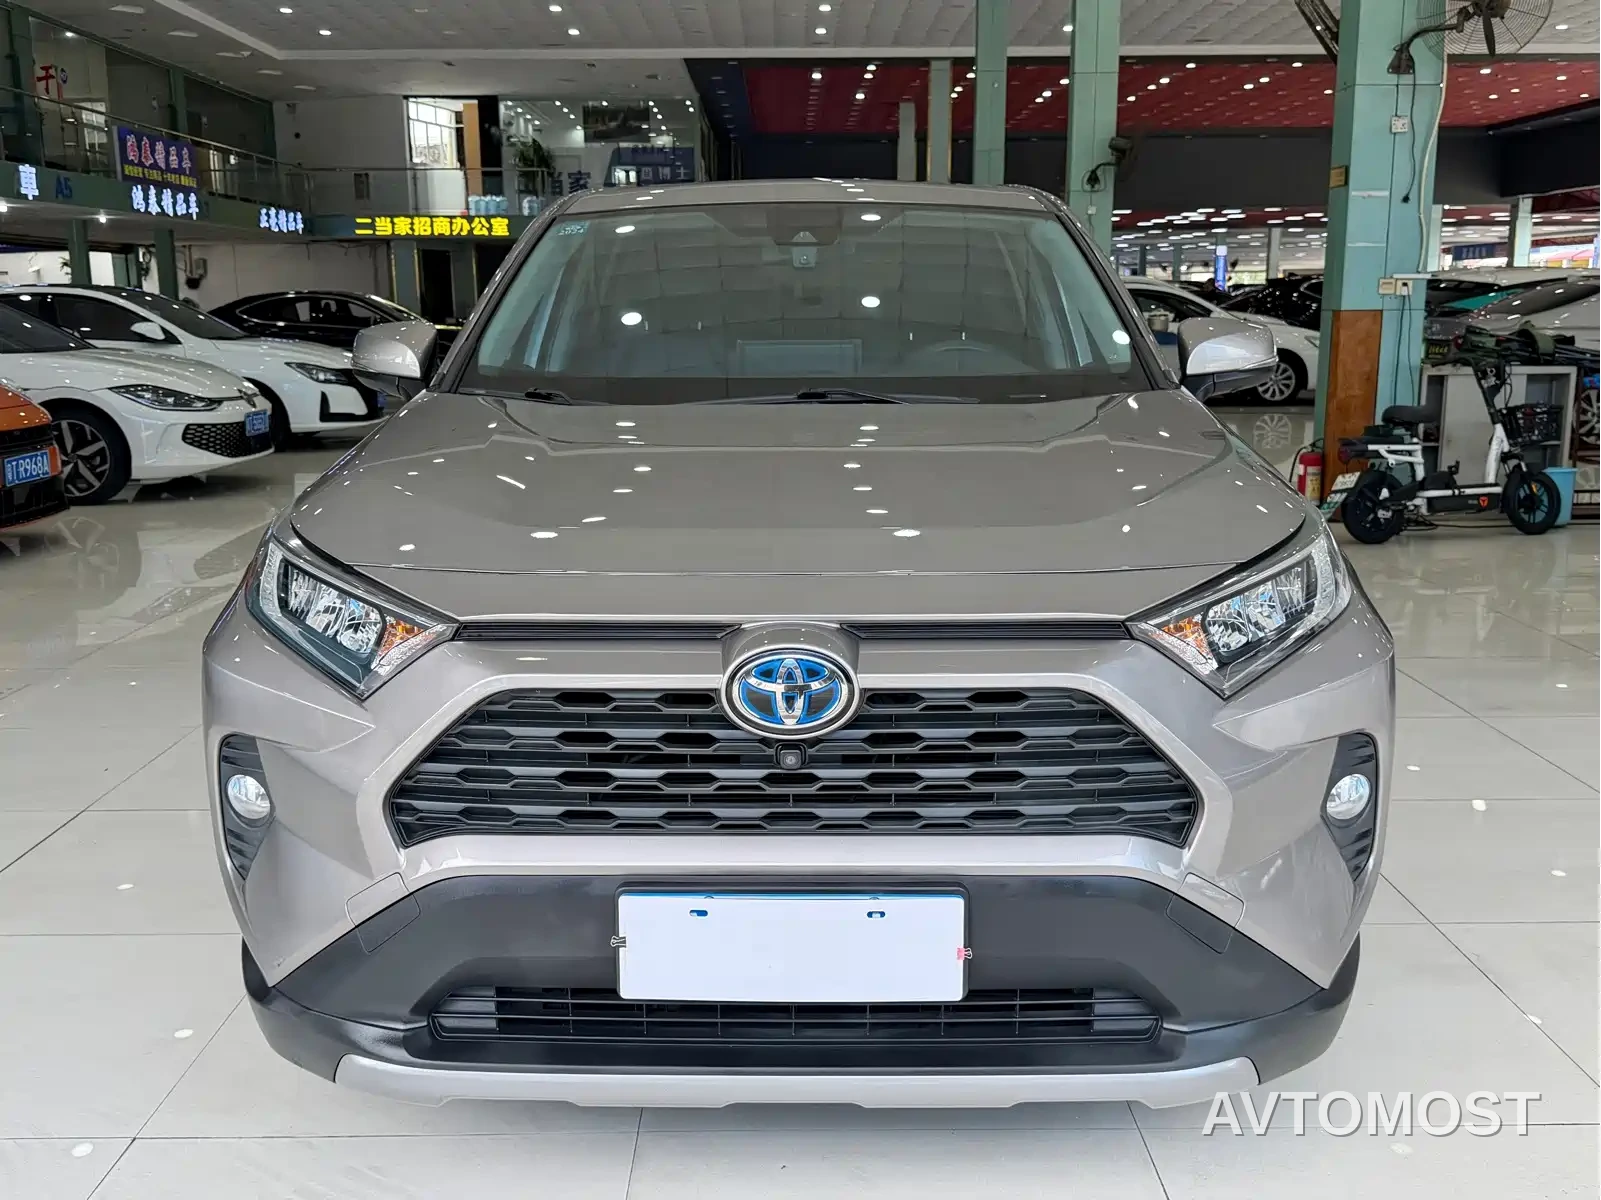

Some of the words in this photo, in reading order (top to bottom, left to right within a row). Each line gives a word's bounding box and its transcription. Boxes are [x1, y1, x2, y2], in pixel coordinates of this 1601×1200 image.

[17, 163, 40, 201] 車
[354, 216, 510, 237] 二当家招商办公室
